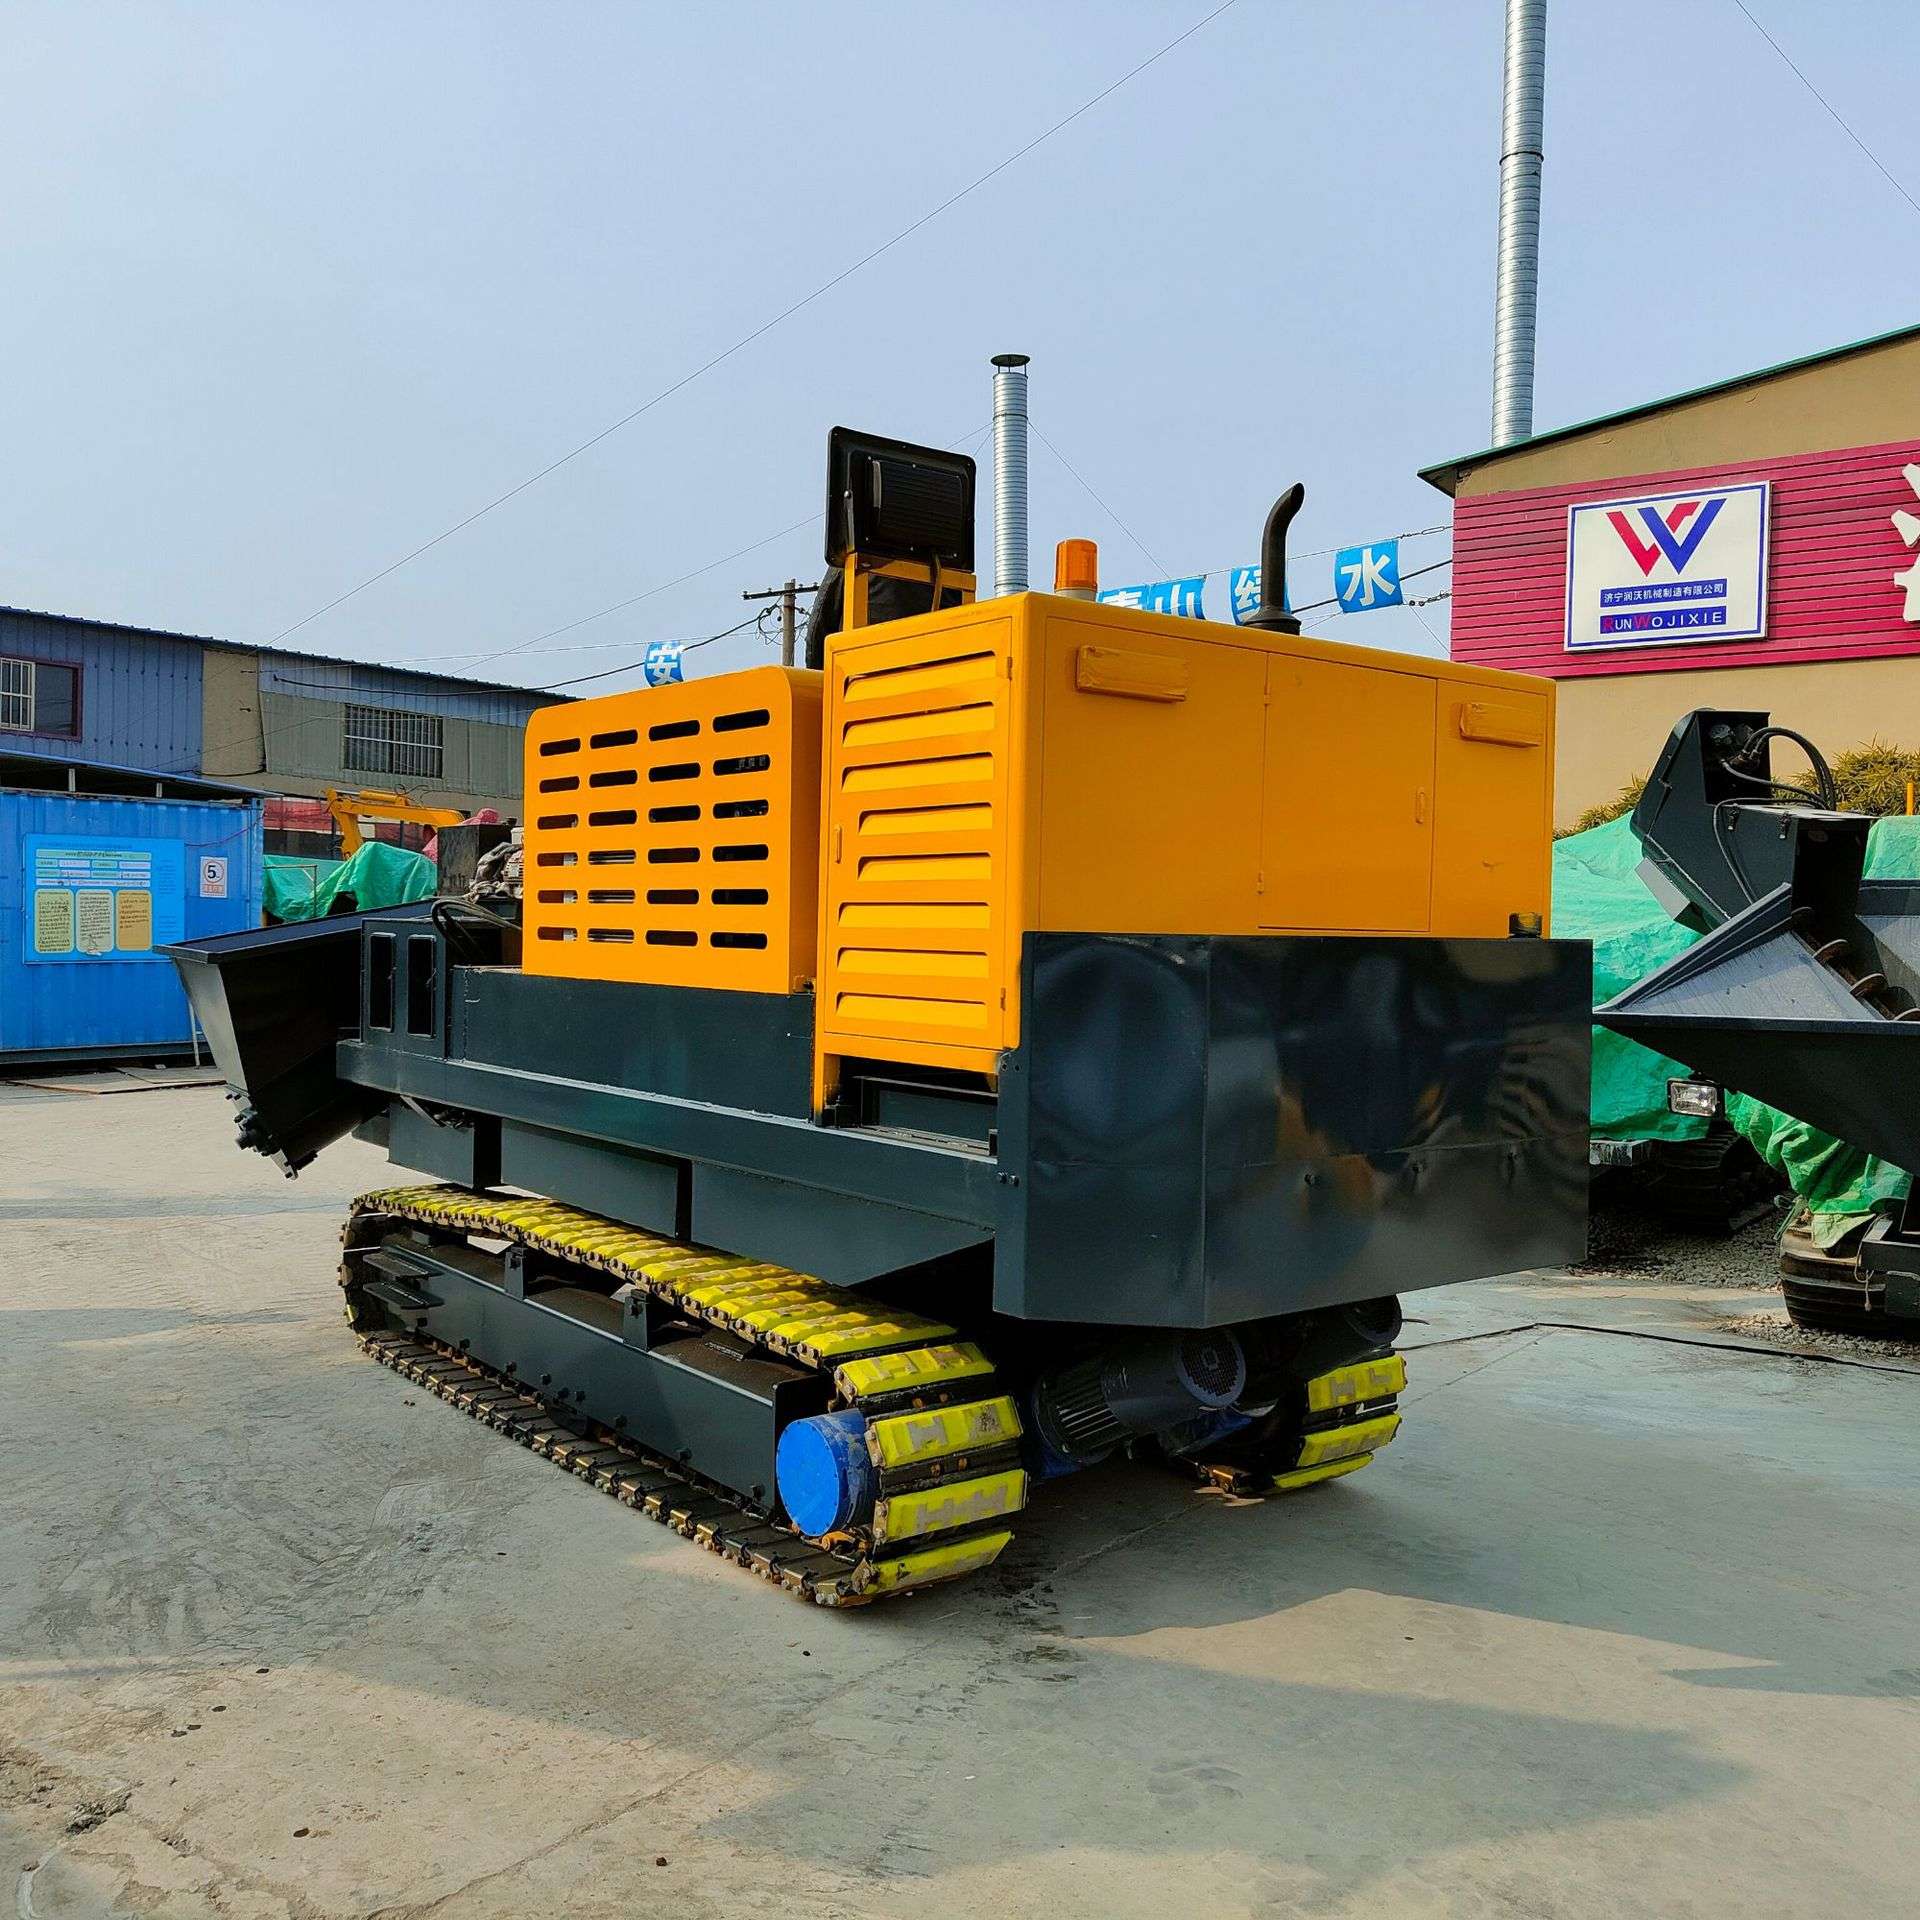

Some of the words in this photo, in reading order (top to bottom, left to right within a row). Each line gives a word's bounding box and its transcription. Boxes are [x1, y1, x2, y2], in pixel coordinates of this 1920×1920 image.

[1341, 547, 1396, 606] 水
[1604, 583, 1723, 603] 济宁润沃机械制造有限公司
[646, 645, 679, 684] 安
[207, 864, 217, 879] 5
